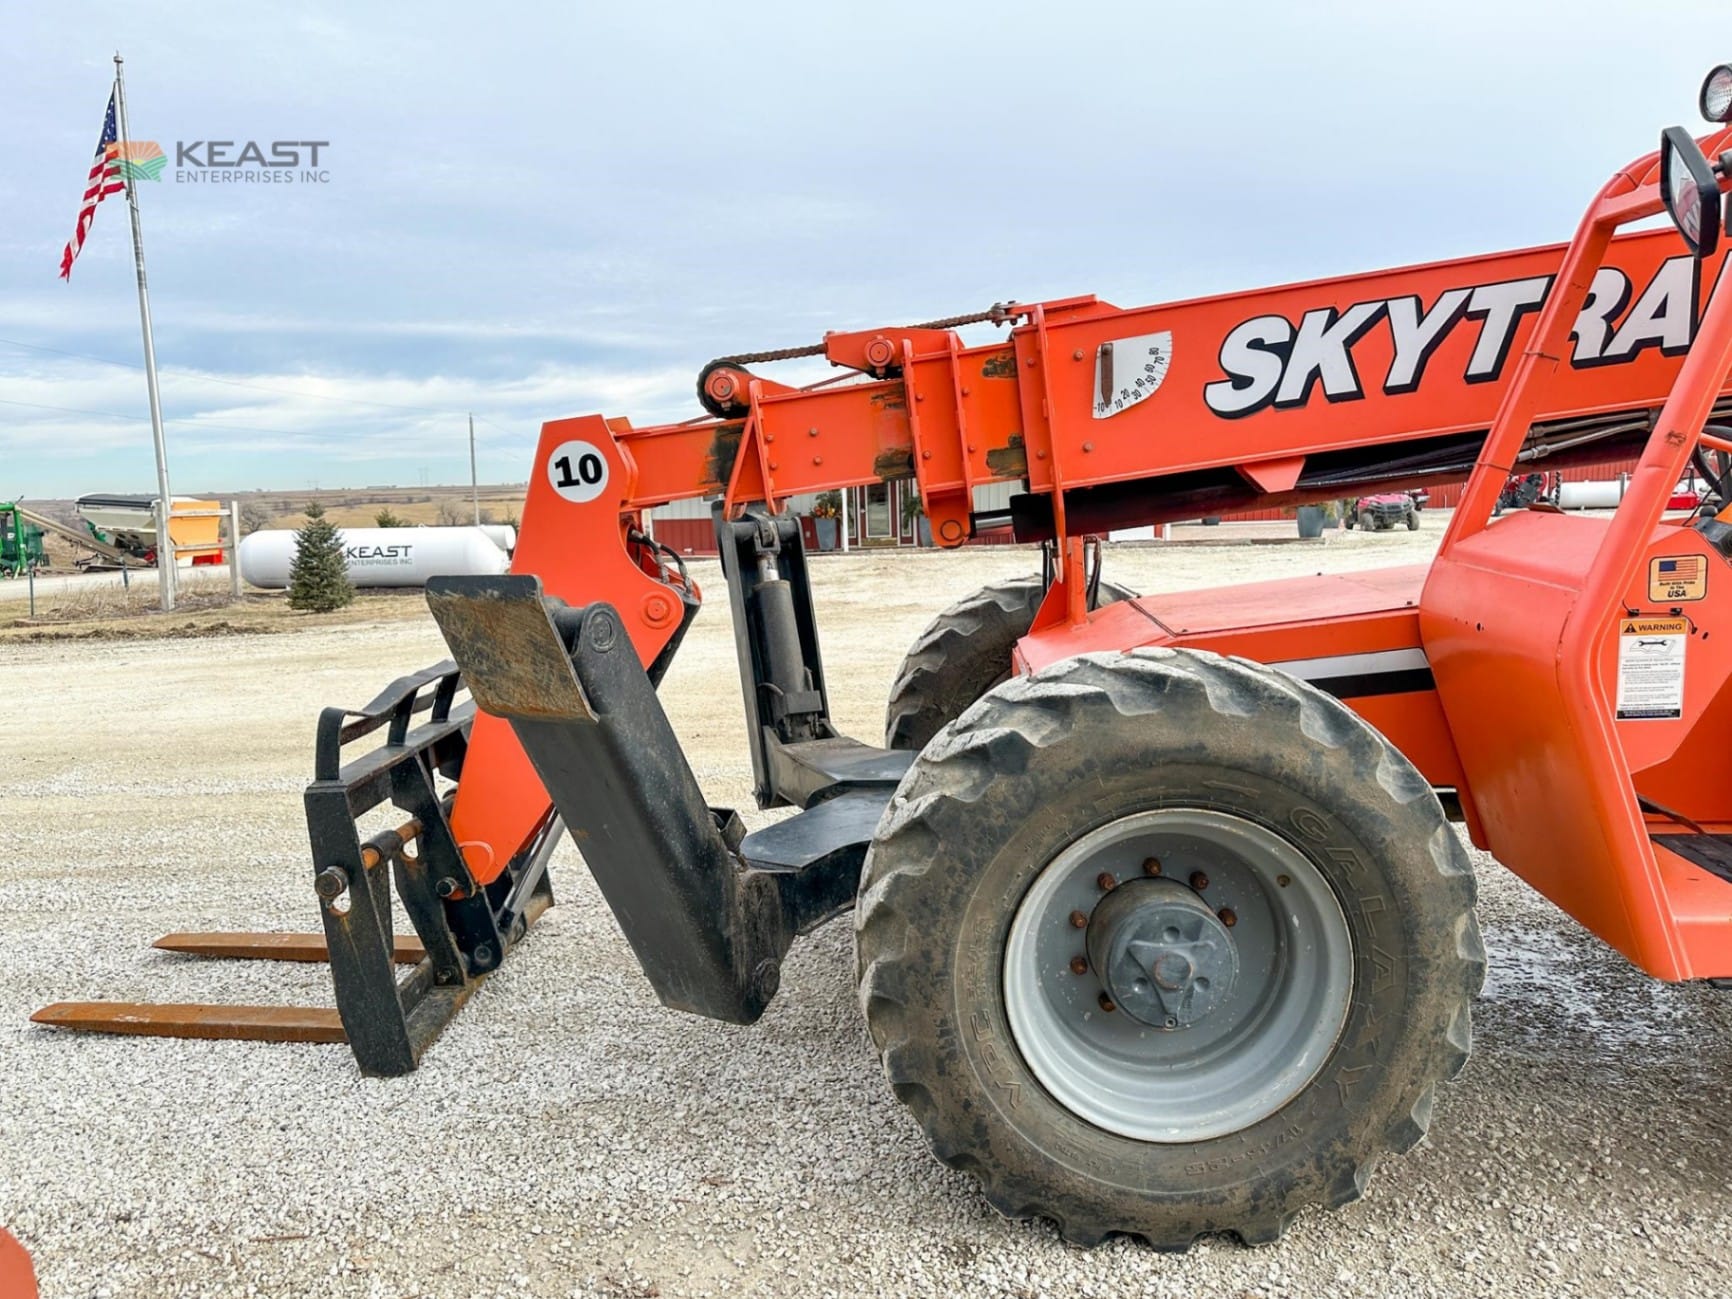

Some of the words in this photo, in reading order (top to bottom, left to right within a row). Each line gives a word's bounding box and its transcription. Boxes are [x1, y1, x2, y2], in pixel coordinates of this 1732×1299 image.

[1203, 248, 1732, 420] SKYTRA
[1148, 347, 1160, 355] 80
[1154, 356, 1165, 365] 70
[1144, 364, 1155, 373] 60
[1145, 375, 1156, 385] 50
[1121, 388, 1130, 400] 20
[1131, 389, 1142, 400] 30
[1114, 399, 1124, 409] 10
[554, 453, 603, 488] 10
[346, 545, 413, 558] KEAST
[1667, 590, 1687, 598] USA
[1638, 623, 1682, 631] WARNING
